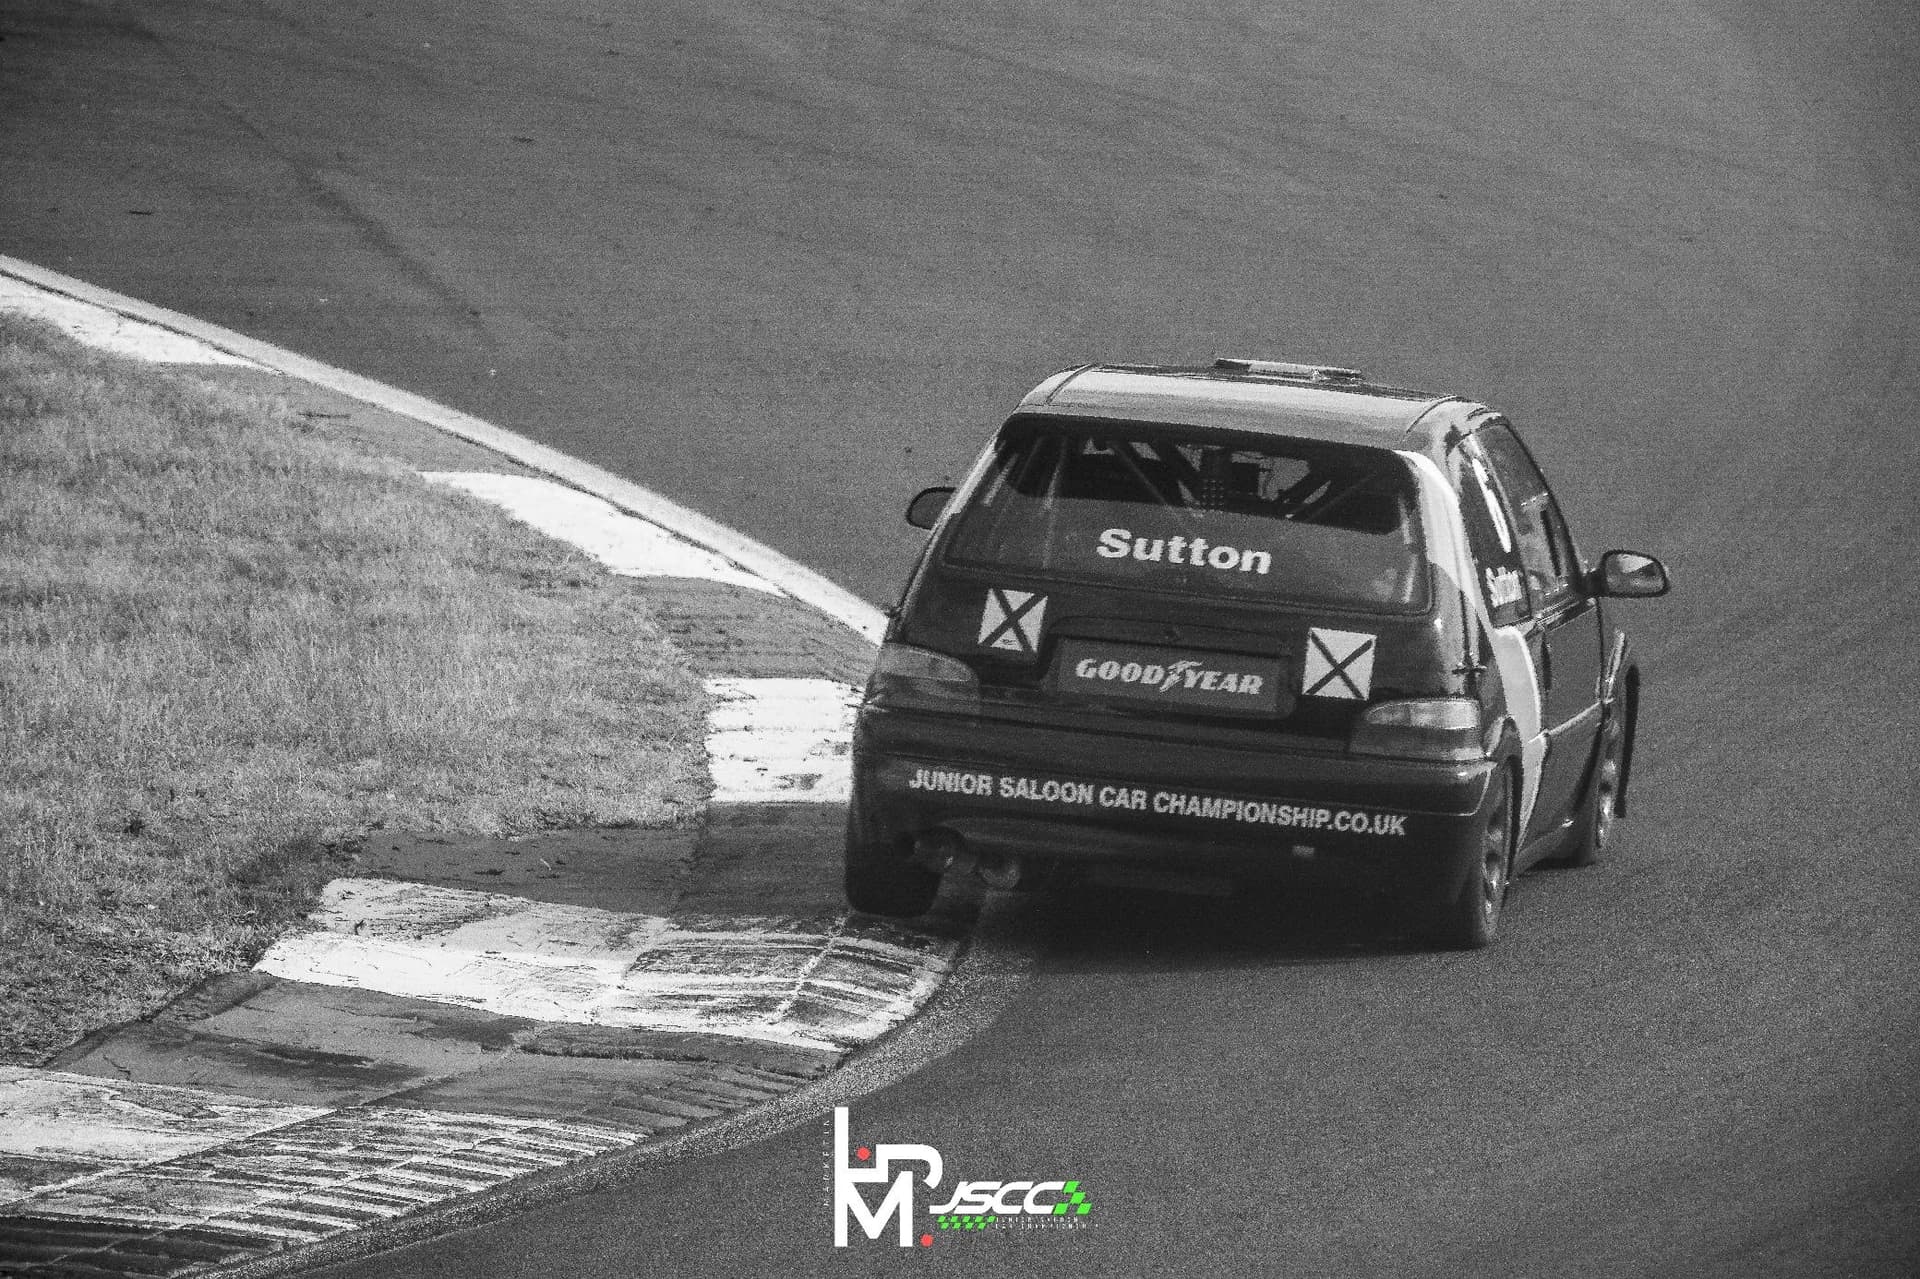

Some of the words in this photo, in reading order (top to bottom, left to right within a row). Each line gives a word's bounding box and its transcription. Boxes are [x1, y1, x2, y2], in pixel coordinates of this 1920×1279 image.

[1096, 528, 1272, 575] Sutton
[1075, 658, 1264, 695] GOODYEAR
[909, 769, 993, 796] JUNIOR
[1000, 777, 1095, 804] SALOON
[1100, 786, 1147, 810] CAR
[1153, 791, 1409, 836] CHAMPIONSHIP.CO.UK
